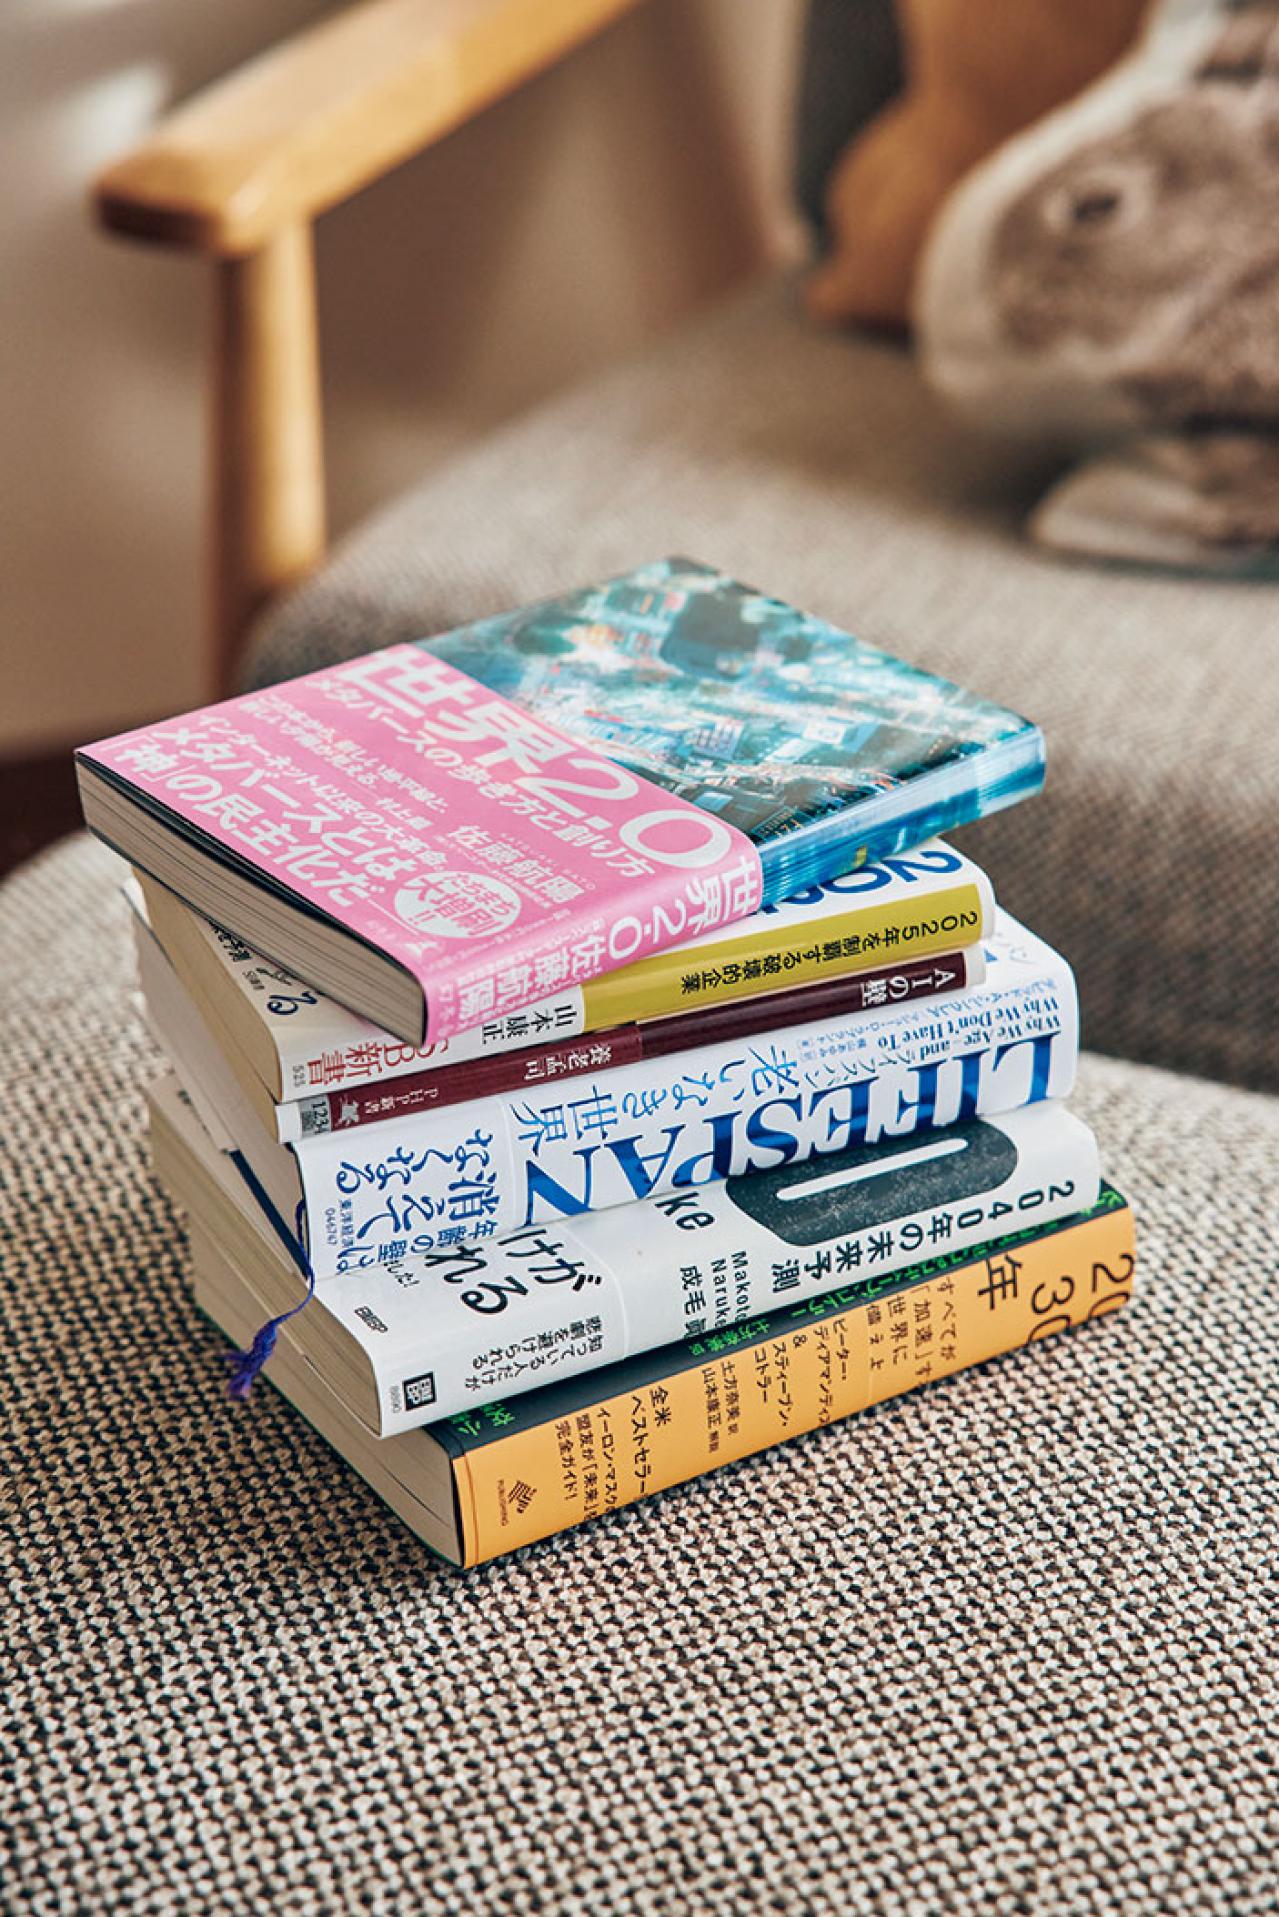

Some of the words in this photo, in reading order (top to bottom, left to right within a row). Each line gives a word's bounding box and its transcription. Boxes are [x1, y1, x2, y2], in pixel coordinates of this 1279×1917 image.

[303, 678, 656, 879] メタバースの歩き方と創り方
[333, 648, 732, 869] 世界2.0
[97, 733, 385, 907] 「神」の民主化だ
[152, 727, 417, 880] メタバースとは
[448, 825, 585, 903] 佐藤航陽
[403, 880, 503, 937] 大増刷
[681, 910, 978, 994] 2025年を制覇する破壊的企業
[861, 968, 957, 1008] AIの壁
[481, 1004, 578, 1046] 山本康正
[523, 1043, 612, 1080] 養老孟司
[510, 1046, 799, 1156] 老いなき世界
[336, 1129, 493, 1194] なくなる
[357, 1172, 500, 1240] 消えて
[771, 1179, 1076, 1295] 2040年の未来予測
[977, 1254, 1023, 1310] 年
[472, 1316, 602, 1369] 悲劇を避けられる
[886, 1296, 908, 1366] 世界に
[937, 1276, 957, 1361] すべてが
[465, 1335, 603, 1392] 知っている人だけが
[753, 1347, 769, 1403] コトラー
[650, 1385, 672, 1427] 全米
[631, 1395, 653, 1494] ベストセラー
